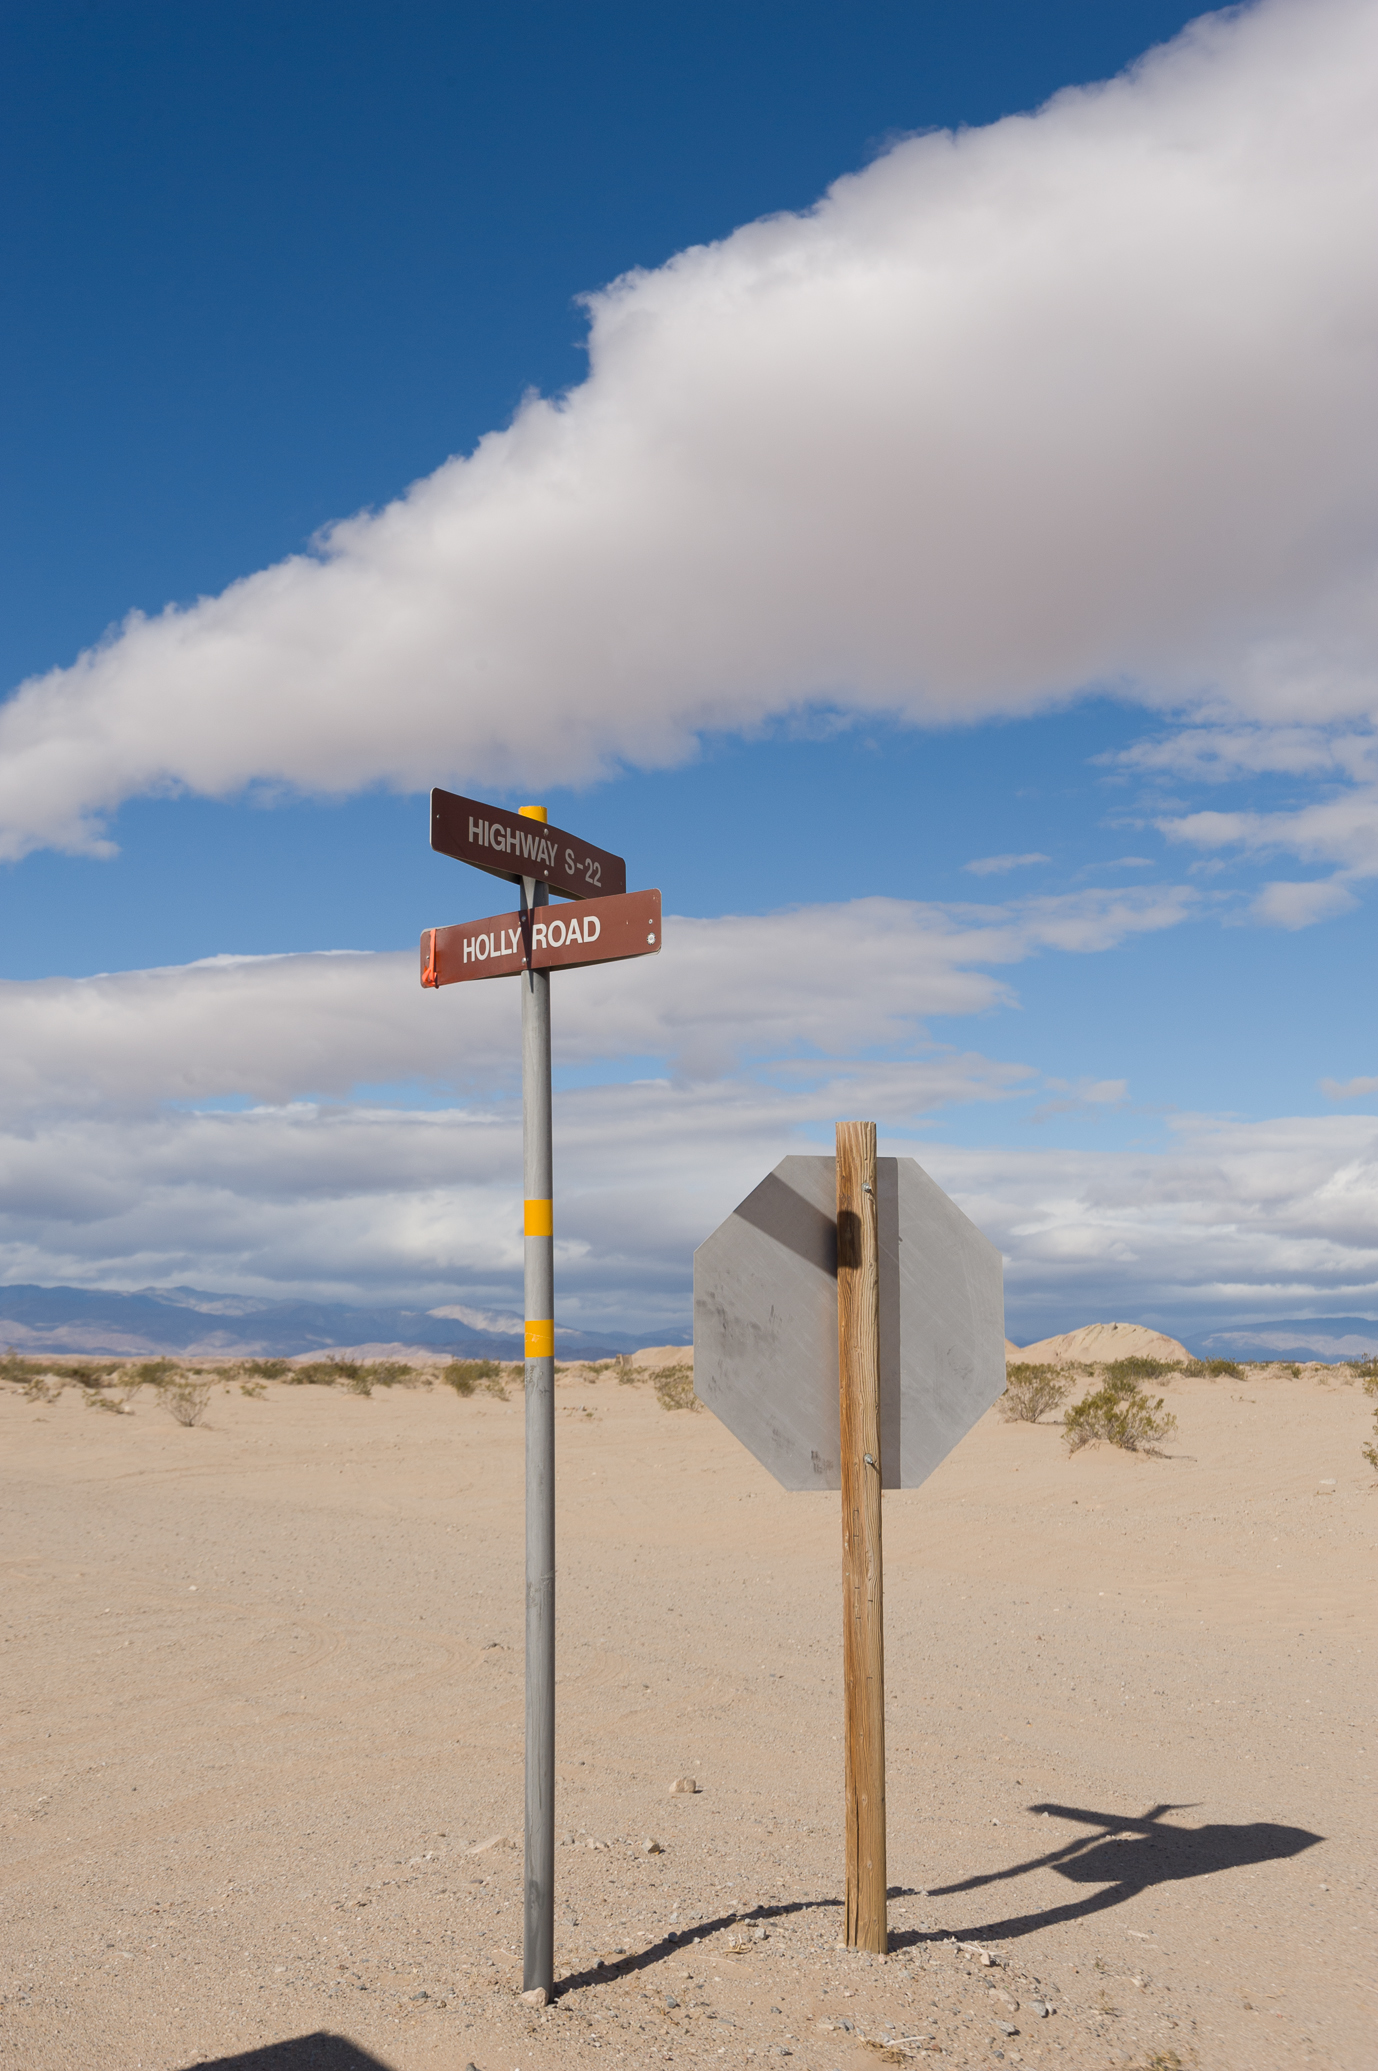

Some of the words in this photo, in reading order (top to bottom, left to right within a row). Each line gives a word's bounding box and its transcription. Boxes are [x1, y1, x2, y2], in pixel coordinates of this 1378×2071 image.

[468, 816, 558, 867] HIGHWAY
[565, 849, 602, 888] S-22
[463, 927, 522, 964] HOLLY
[532, 915, 601, 950] ROAD
